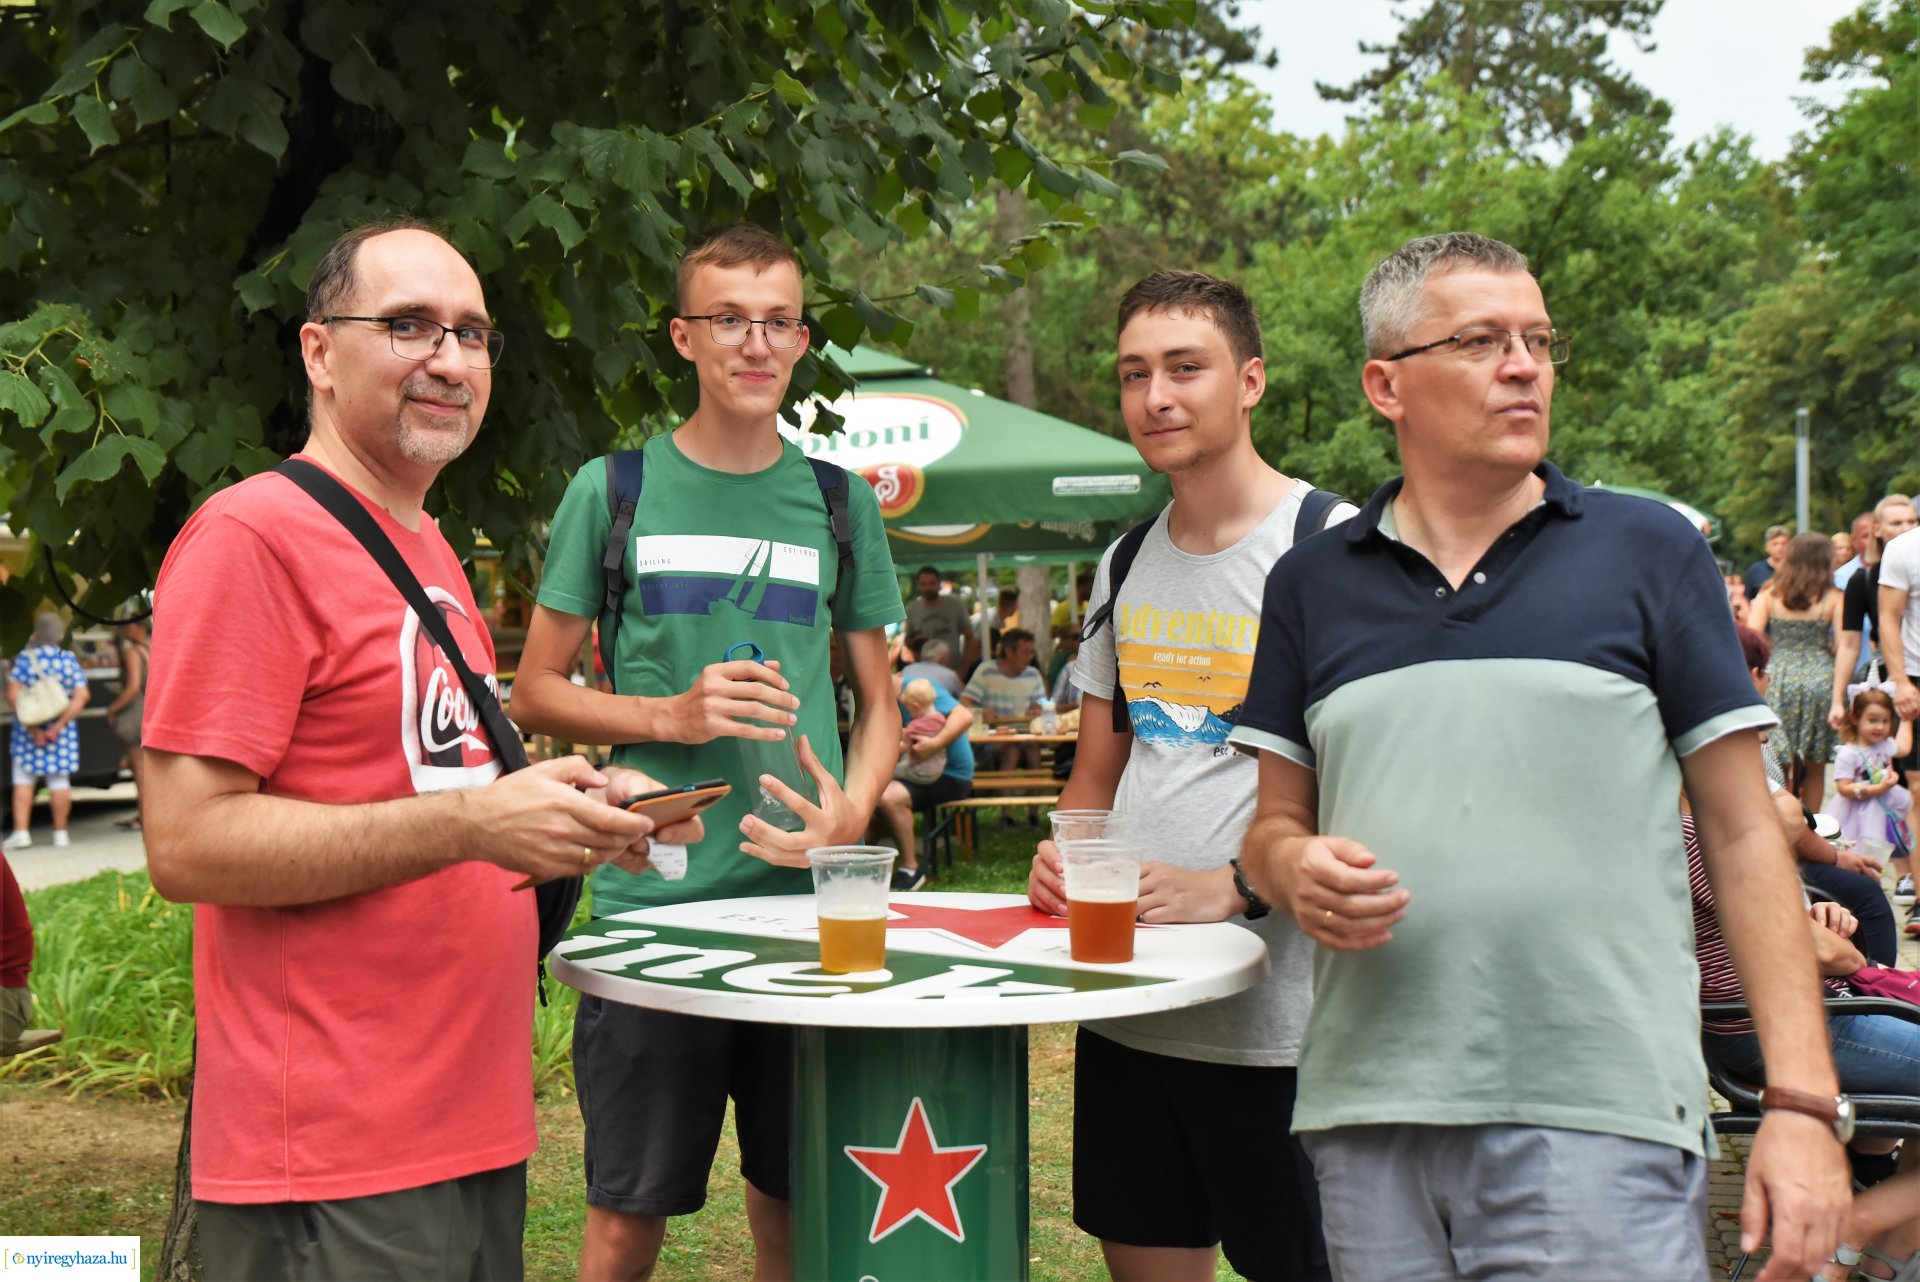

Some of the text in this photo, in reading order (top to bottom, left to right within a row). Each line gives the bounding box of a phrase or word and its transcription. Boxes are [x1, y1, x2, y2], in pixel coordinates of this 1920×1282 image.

[639, 558, 671, 567] SAILING
[1153, 651, 1175, 665] ready
[1188, 655, 1212, 667] action
